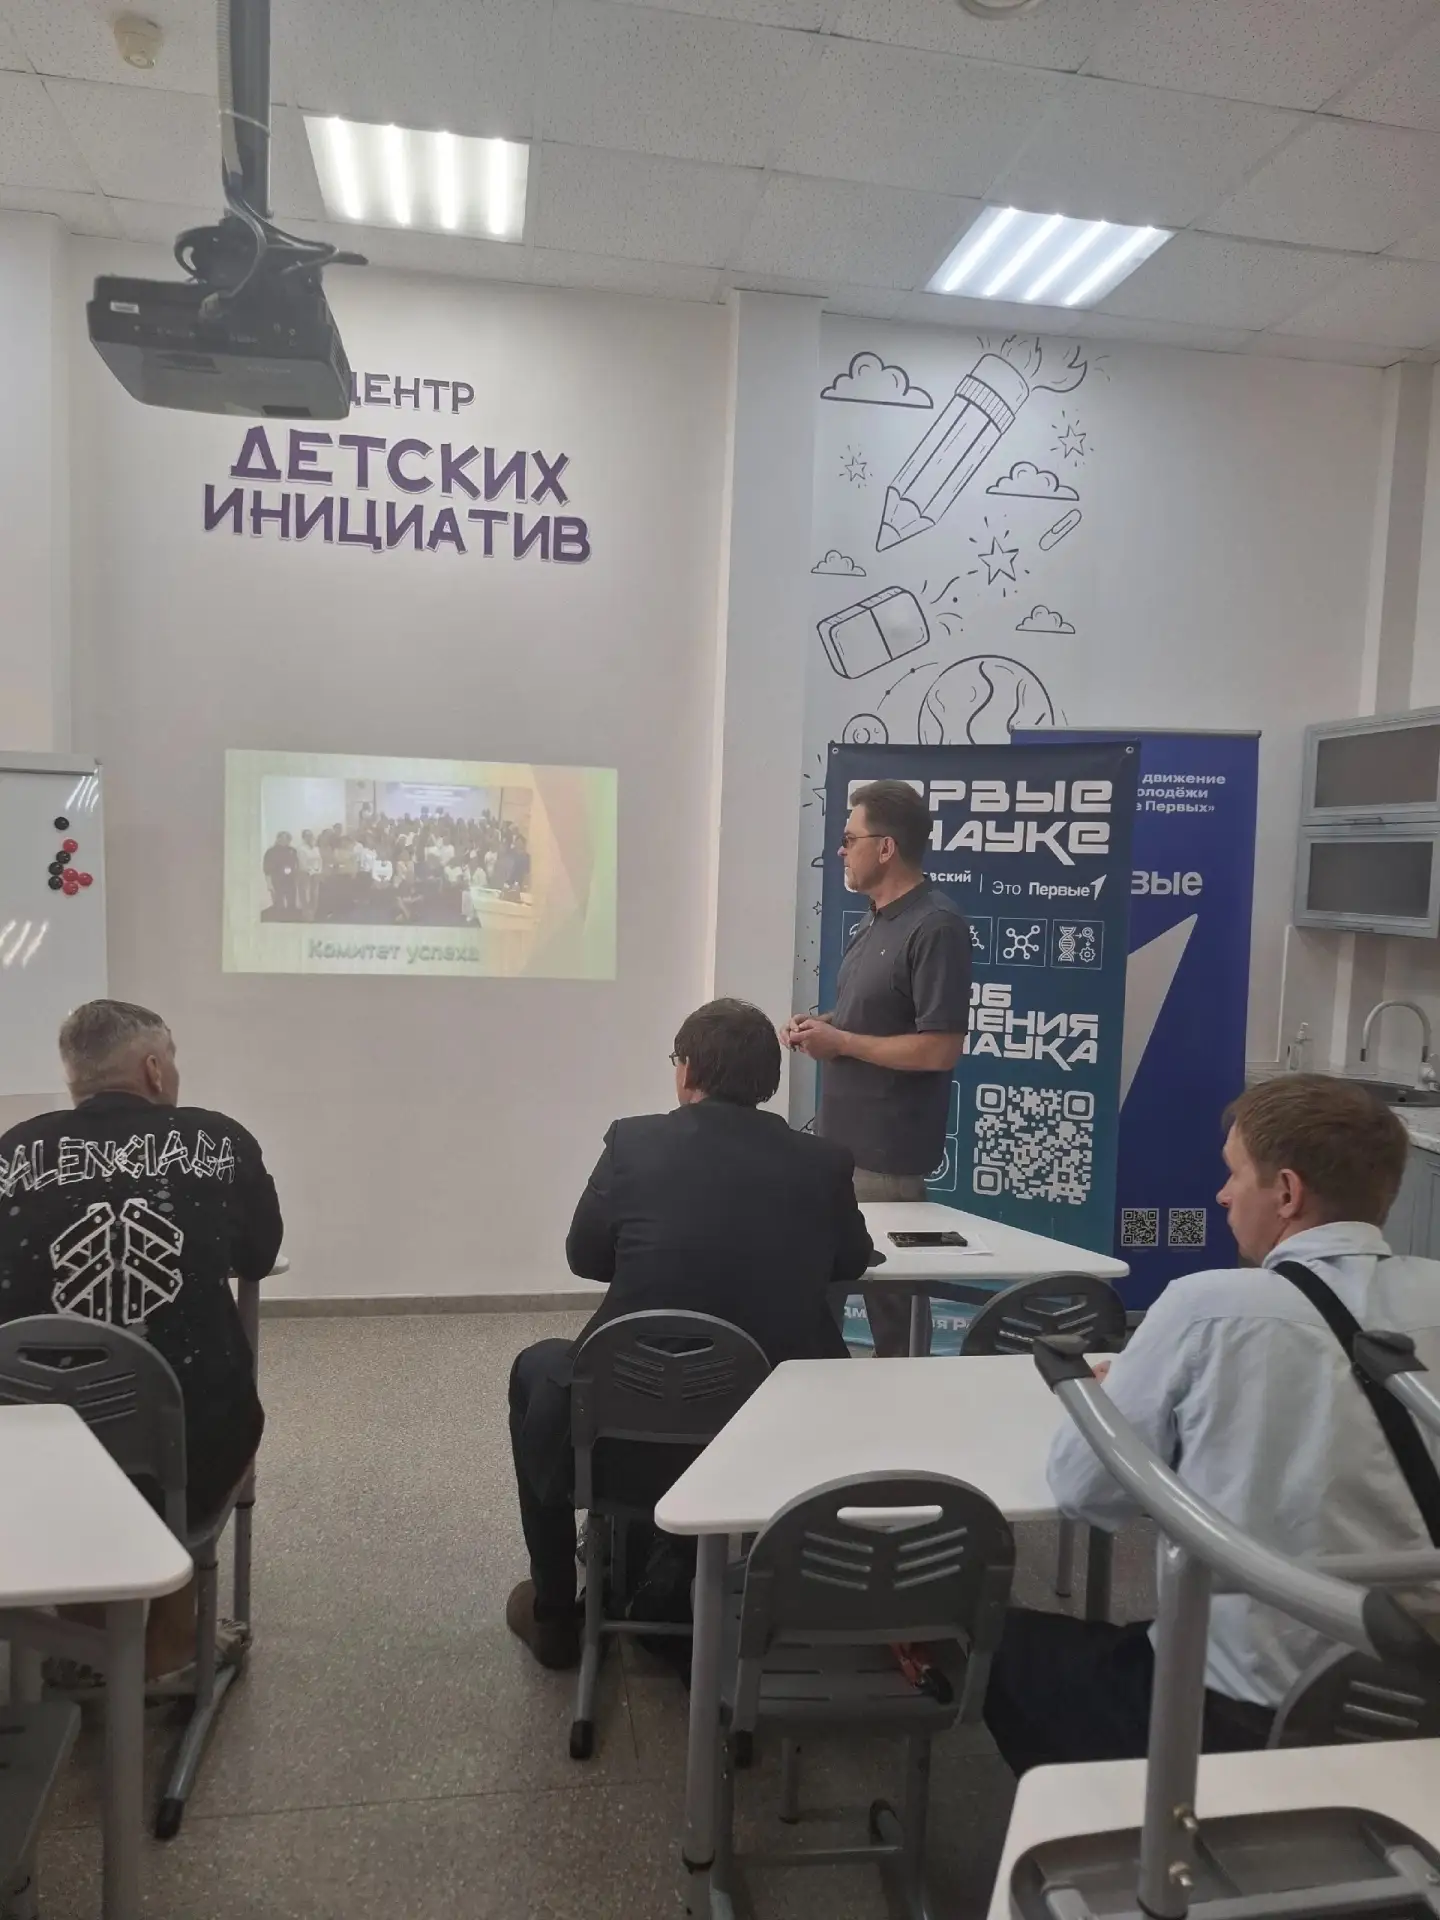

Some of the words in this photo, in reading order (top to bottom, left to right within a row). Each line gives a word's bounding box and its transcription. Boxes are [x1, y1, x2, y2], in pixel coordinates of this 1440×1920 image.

[229, 425, 570, 506] ДЕТСКИХ
[203, 482, 592, 564] ИНИЦИАТИВ
[1142, 774, 1226, 785] движение
[847, 779, 1113, 813] РВЫЕ
[1145, 800, 1215, 814] Первых»
[923, 870, 972, 883] вский
[991, 880, 1022, 895] Это
[1028, 881, 1091, 900] Первые
[308, 939, 400, 960] Комитет
[967, 1006, 1099, 1039] ЕНИЯ
